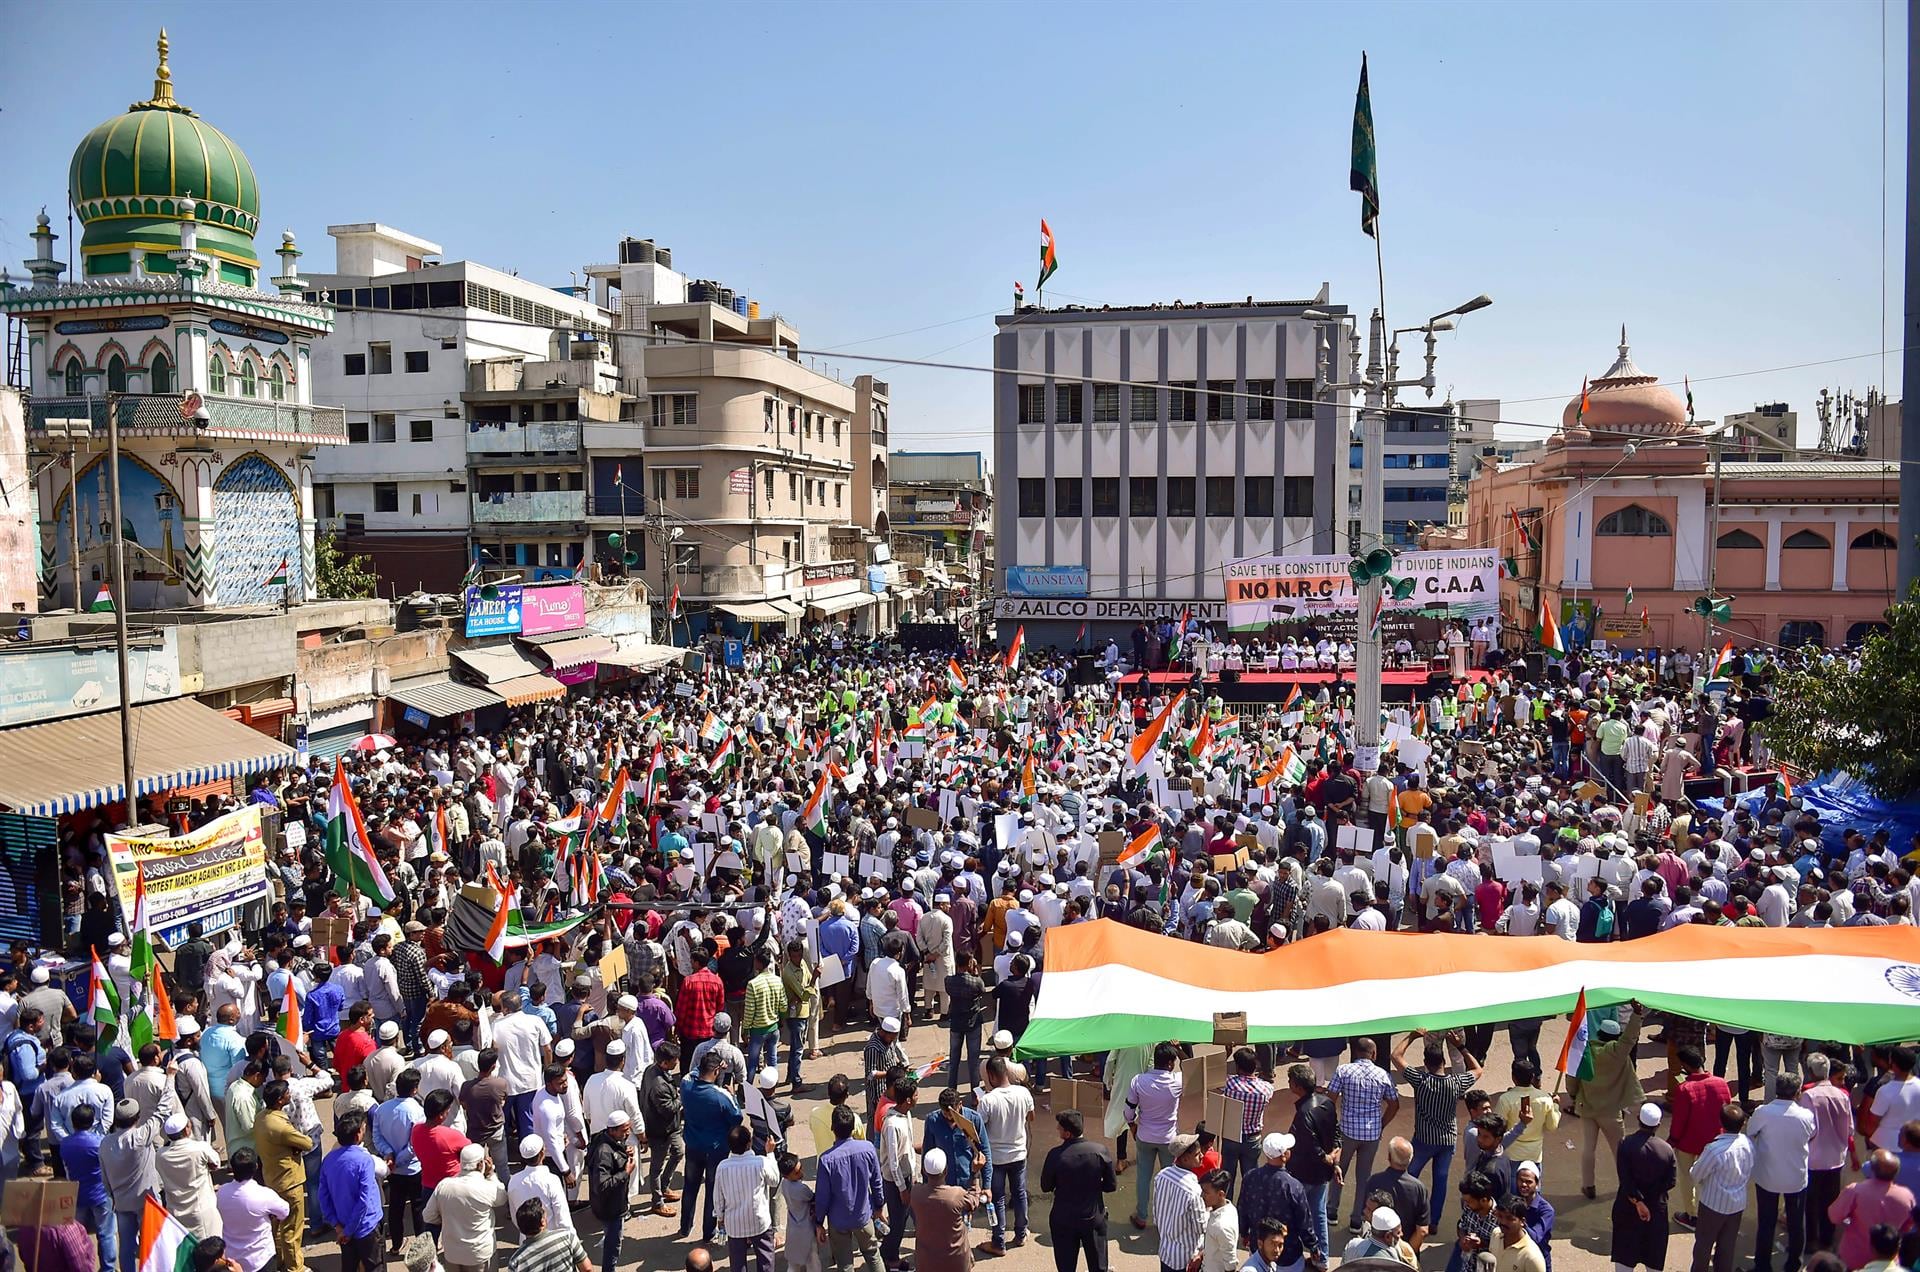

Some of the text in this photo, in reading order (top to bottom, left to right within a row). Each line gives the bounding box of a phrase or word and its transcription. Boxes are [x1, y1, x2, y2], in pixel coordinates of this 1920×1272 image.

[953, 511, 970, 520] HOTEL
[1230, 565, 1257, 577] SAVE
[1260, 563, 1281, 576] THE
[1284, 561, 1351, 575] CONSTITUT
[1406, 558, 1443, 571] DIVIDE
[1447, 556, 1494, 569] INDIANS
[1025, 574, 1084, 585] JANSEVA
[1238, 582, 1269, 600] NO
[1275, 579, 1333, 598] N.R.C
[1424, 575, 1485, 594] C.A.A
[469, 600, 507, 616] ZAMEER
[540, 598, 571, 616] Luna
[1017, 601, 1088, 616] AALCO
[471, 616, 505, 627] TEA HOUSE
[728, 642, 738, 656] P
[129, 842, 154, 857] NRC
[174, 840, 196, 853] CAA
[174, 874, 197, 889] MARCH
[198, 866, 224, 881] AGAINST
[224, 860, 237, 874] NRC
[242, 857, 253, 869] CAA
[170, 908, 232, 946] H.K ROAD
